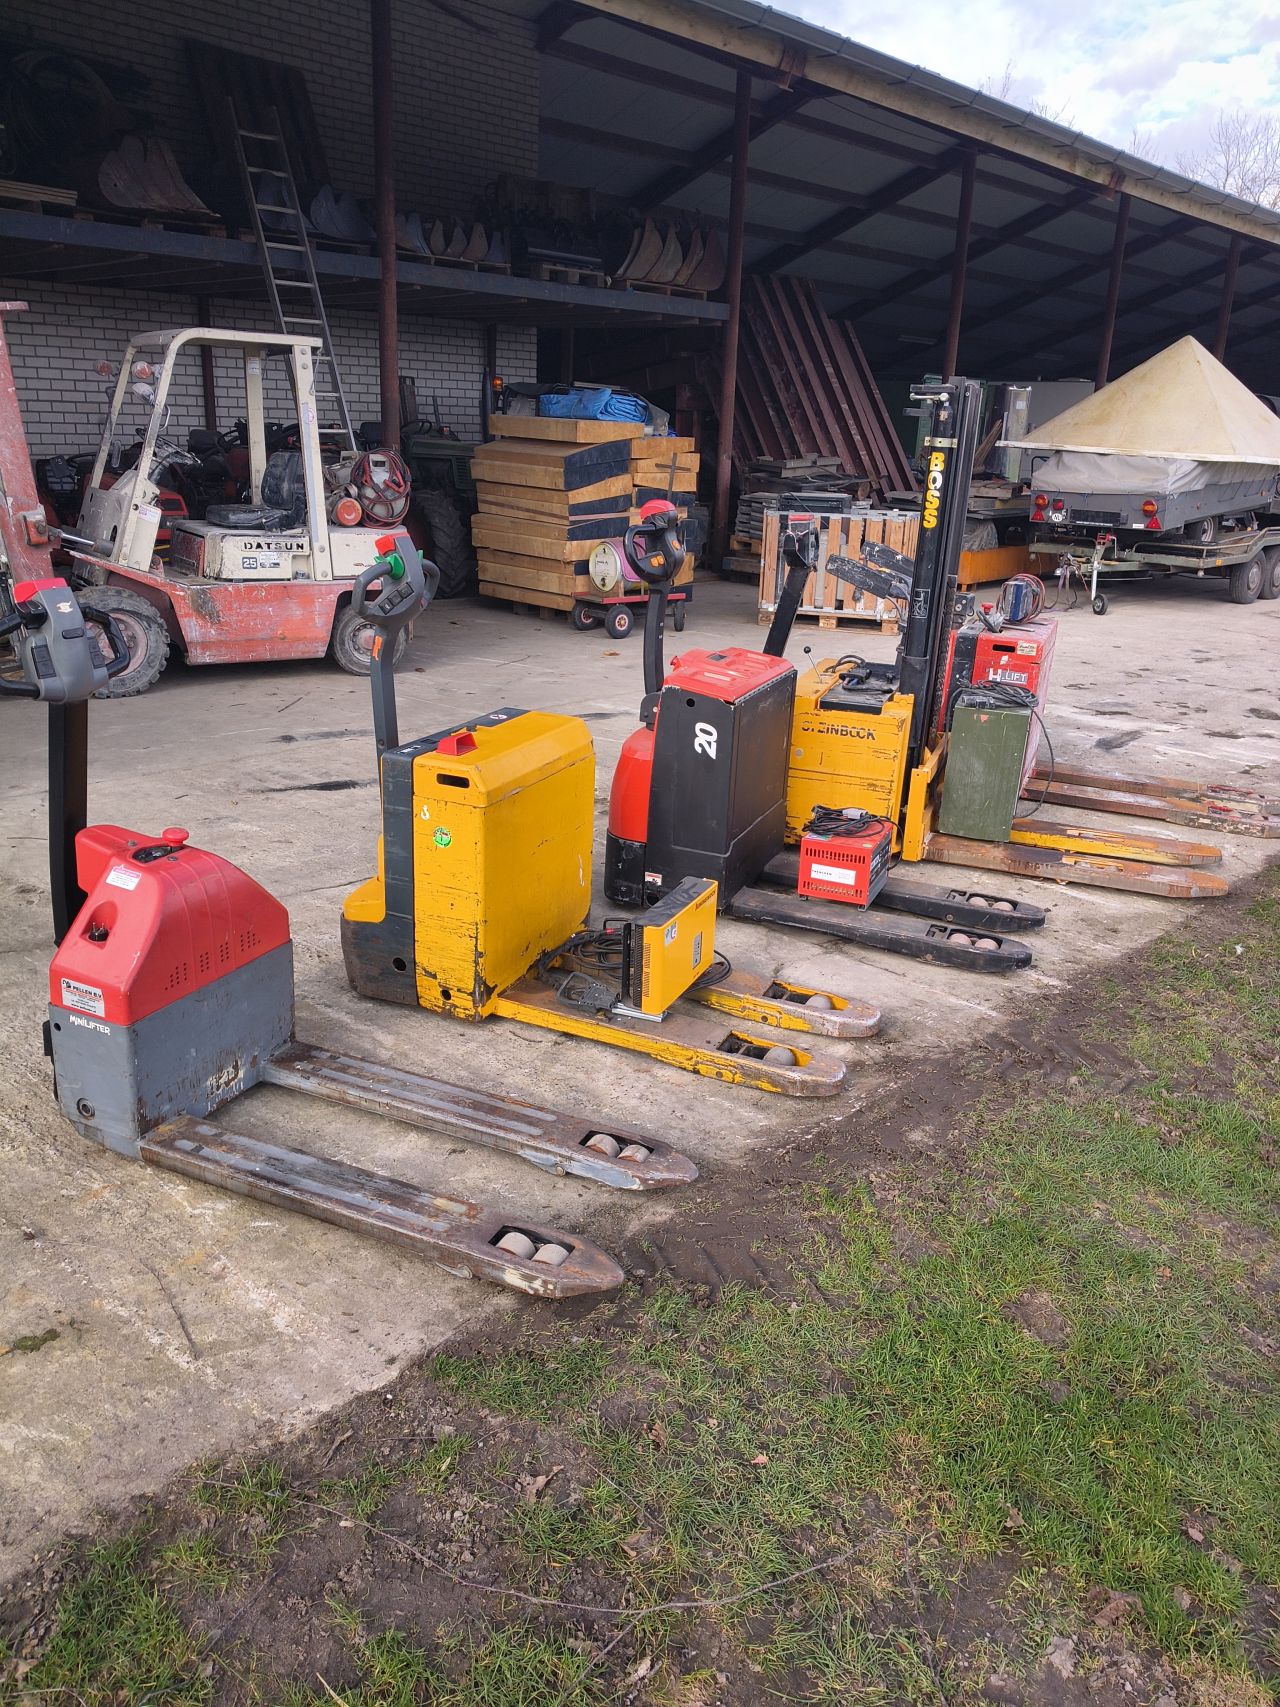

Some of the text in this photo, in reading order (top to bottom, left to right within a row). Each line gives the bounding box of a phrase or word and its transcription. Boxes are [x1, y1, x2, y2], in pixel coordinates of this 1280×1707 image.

[923, 452, 945, 529] BOSS
[243, 541, 304, 551] DATSUN
[243, 559, 257, 569] 25
[694, 722, 718, 760] 20
